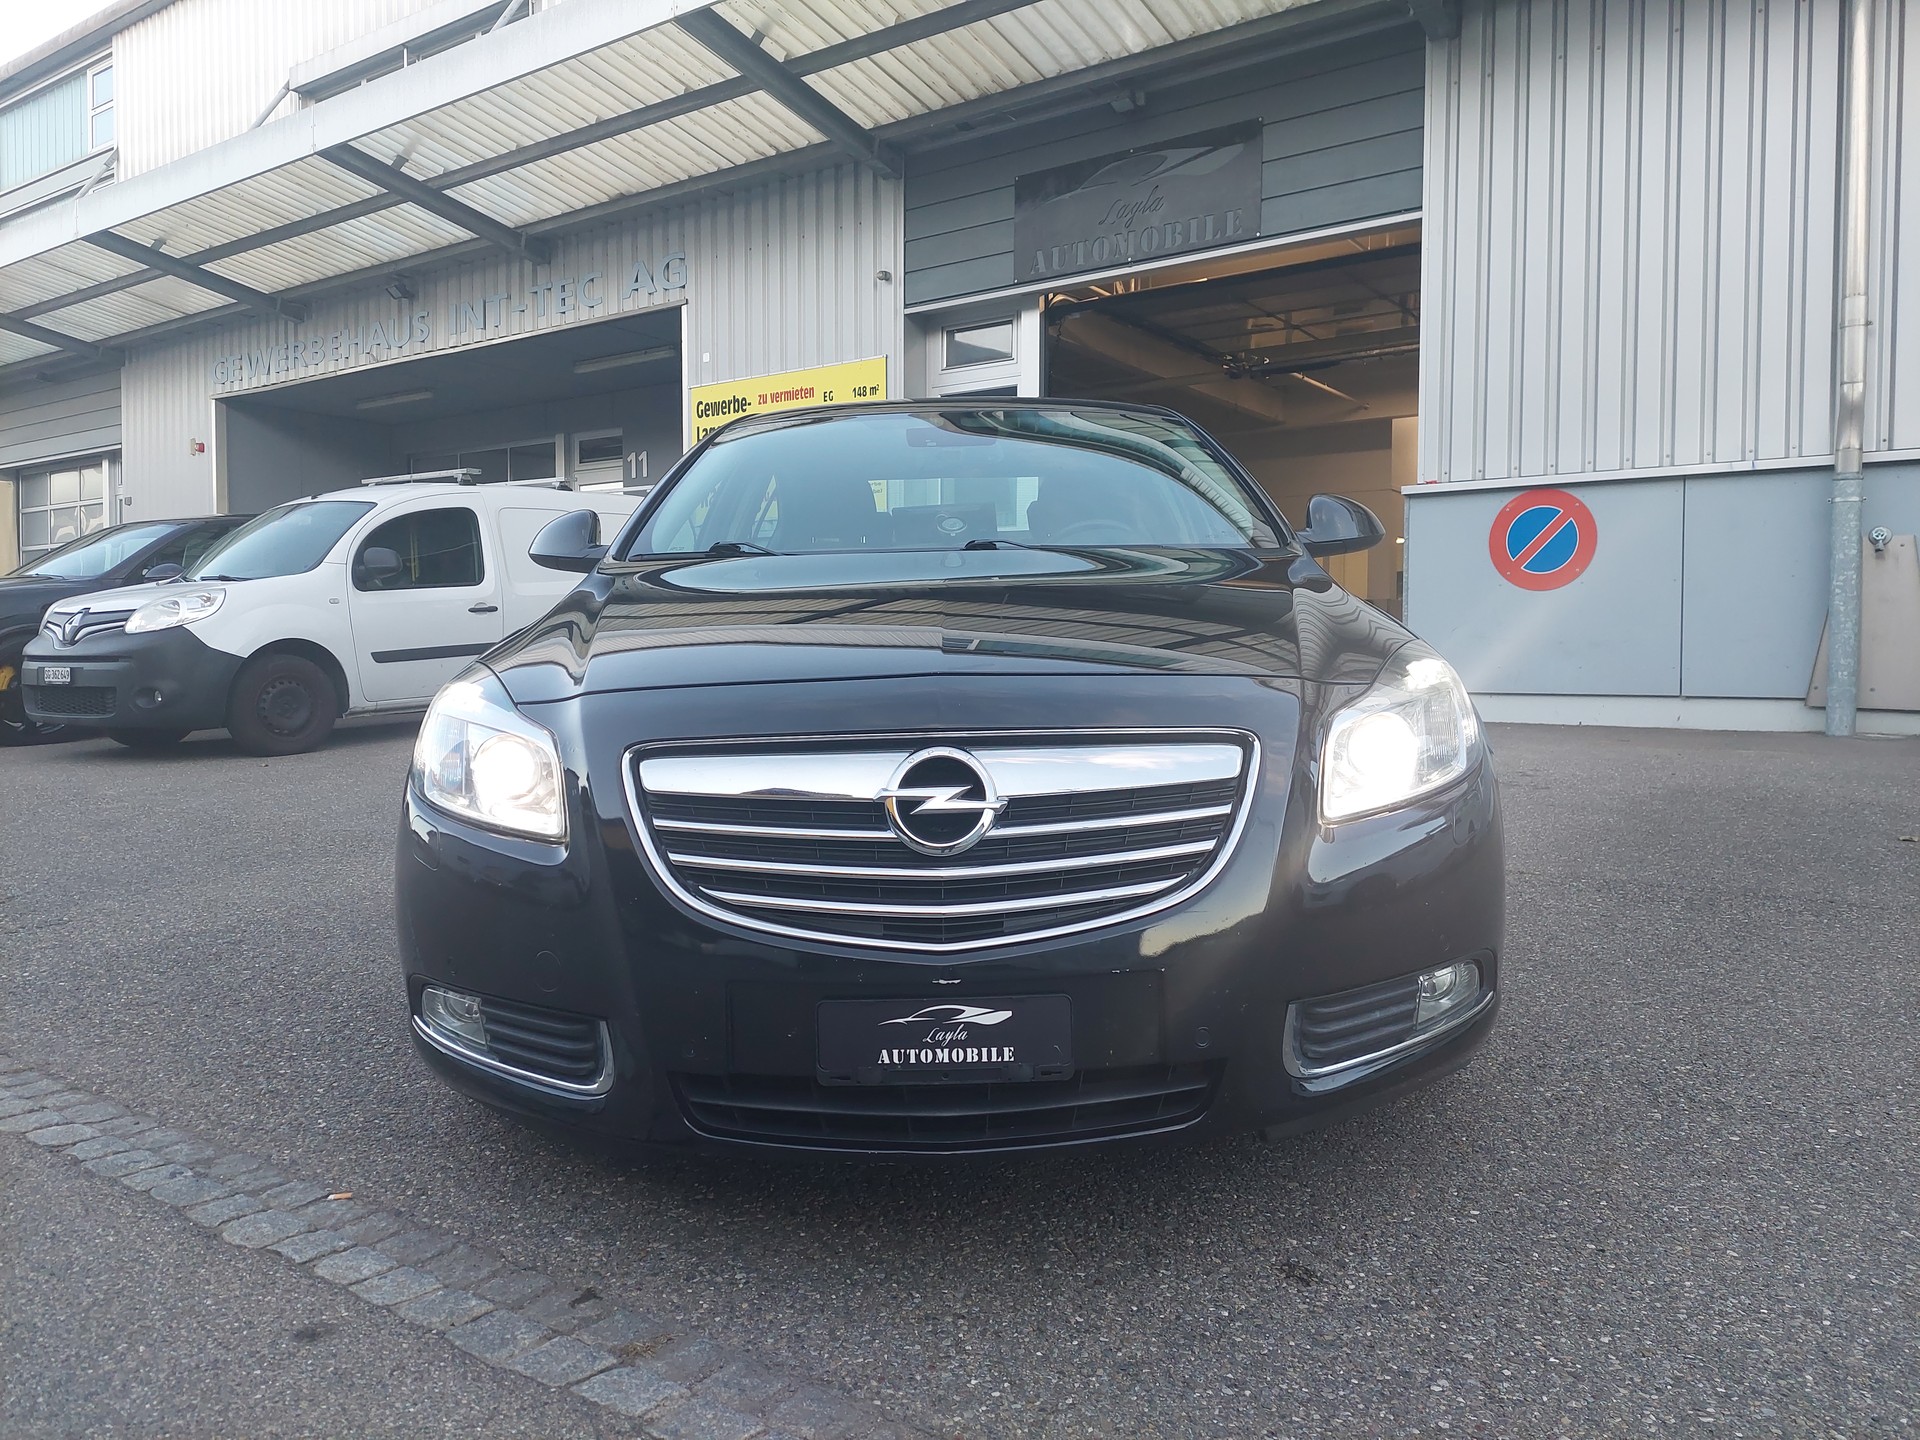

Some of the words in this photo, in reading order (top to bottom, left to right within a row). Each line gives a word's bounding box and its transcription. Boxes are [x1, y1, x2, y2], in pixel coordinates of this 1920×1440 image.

[1098, 185, 1165, 229] Layla
[1030, 207, 1244, 275] AUTOMOBILE
[210, 310, 431, 385] GEWERBEHAUS
[622, 252, 688, 299] AG
[757, 392, 768, 406] zu
[769, 385, 815, 404] vermieten
[823, 390, 834, 403] EG
[852, 385, 868, 399] 148
[696, 394, 752, 419] Gewerbe-
[626, 450, 648, 479] 11
[907, 749, 973, 764] OPEL
[922, 1023, 968, 1047] Layla
[877, 1046, 1015, 1065] AUTOMOBILE
